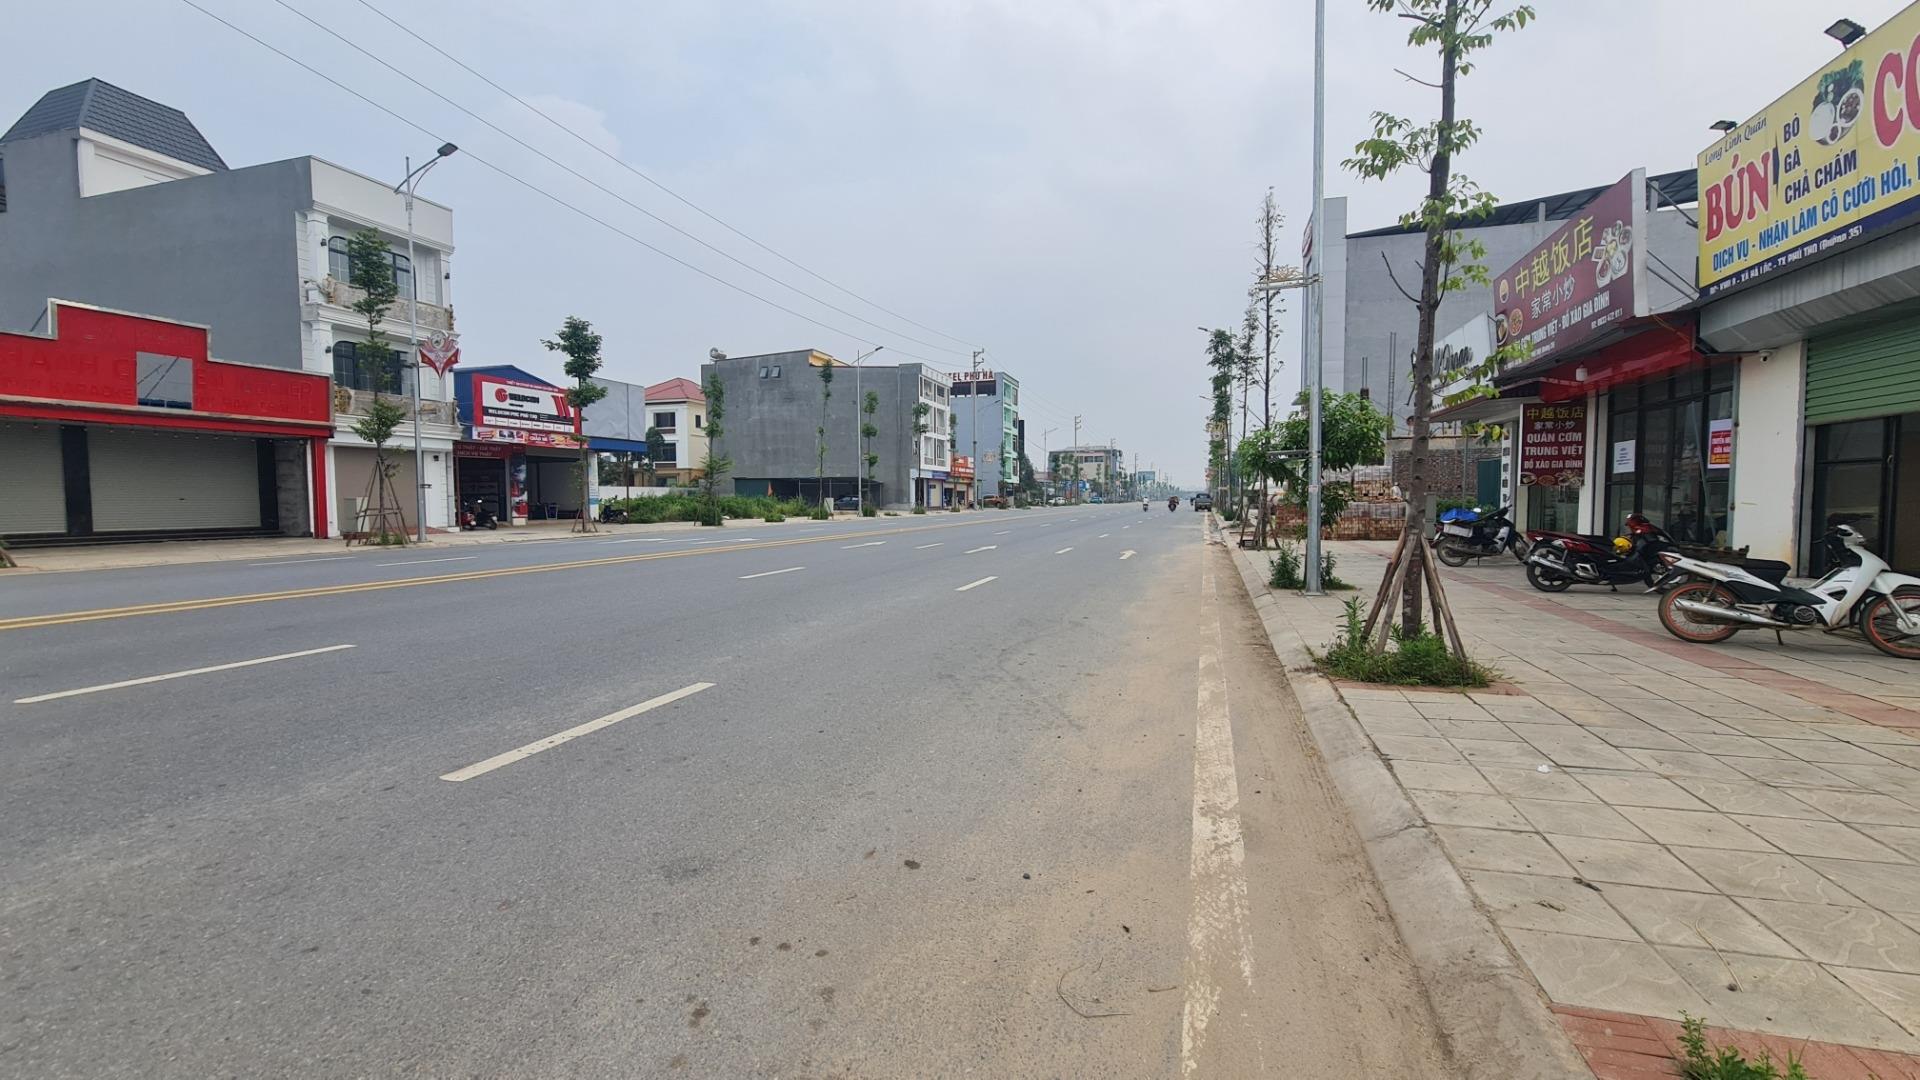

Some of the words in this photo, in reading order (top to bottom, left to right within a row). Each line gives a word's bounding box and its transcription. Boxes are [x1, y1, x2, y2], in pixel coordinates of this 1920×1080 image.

[1783, 112, 1800, 143] BÒ
[1784, 145, 1801, 174] GÀ
[1784, 168, 1811, 205] CHẢ
[1814, 148, 1857, 189] CHẤM
[1705, 151, 1771, 242] BÚN
[1713, 245, 1734, 273] DỊCH
[1736, 238, 1749, 261] VỤ
[1758, 219, 1789, 250] NHẬN
[1792, 205, 1818, 236] LÀM
[1843, 175, 1876, 212] CƯỚI
[1514, 216, 1594, 299] 中越饭店
[1547, 318, 1558, 338] VIỆT
[1570, 305, 1582, 326] XÀO
[1582, 299, 1593, 318] GIA
[1526, 406, 1585, 420] 中越饭店
[1525, 446, 1558, 456] TRUNG
[1561, 444, 1584, 457] VIỆT
[1527, 431, 1556, 444] QUÁN
[1558, 431, 1582, 442] CƠM
[1535, 459, 1550, 469] XÀO
[1551, 460, 1564, 468] GIA
[1565, 458, 1583, 468] ĐÌNH
